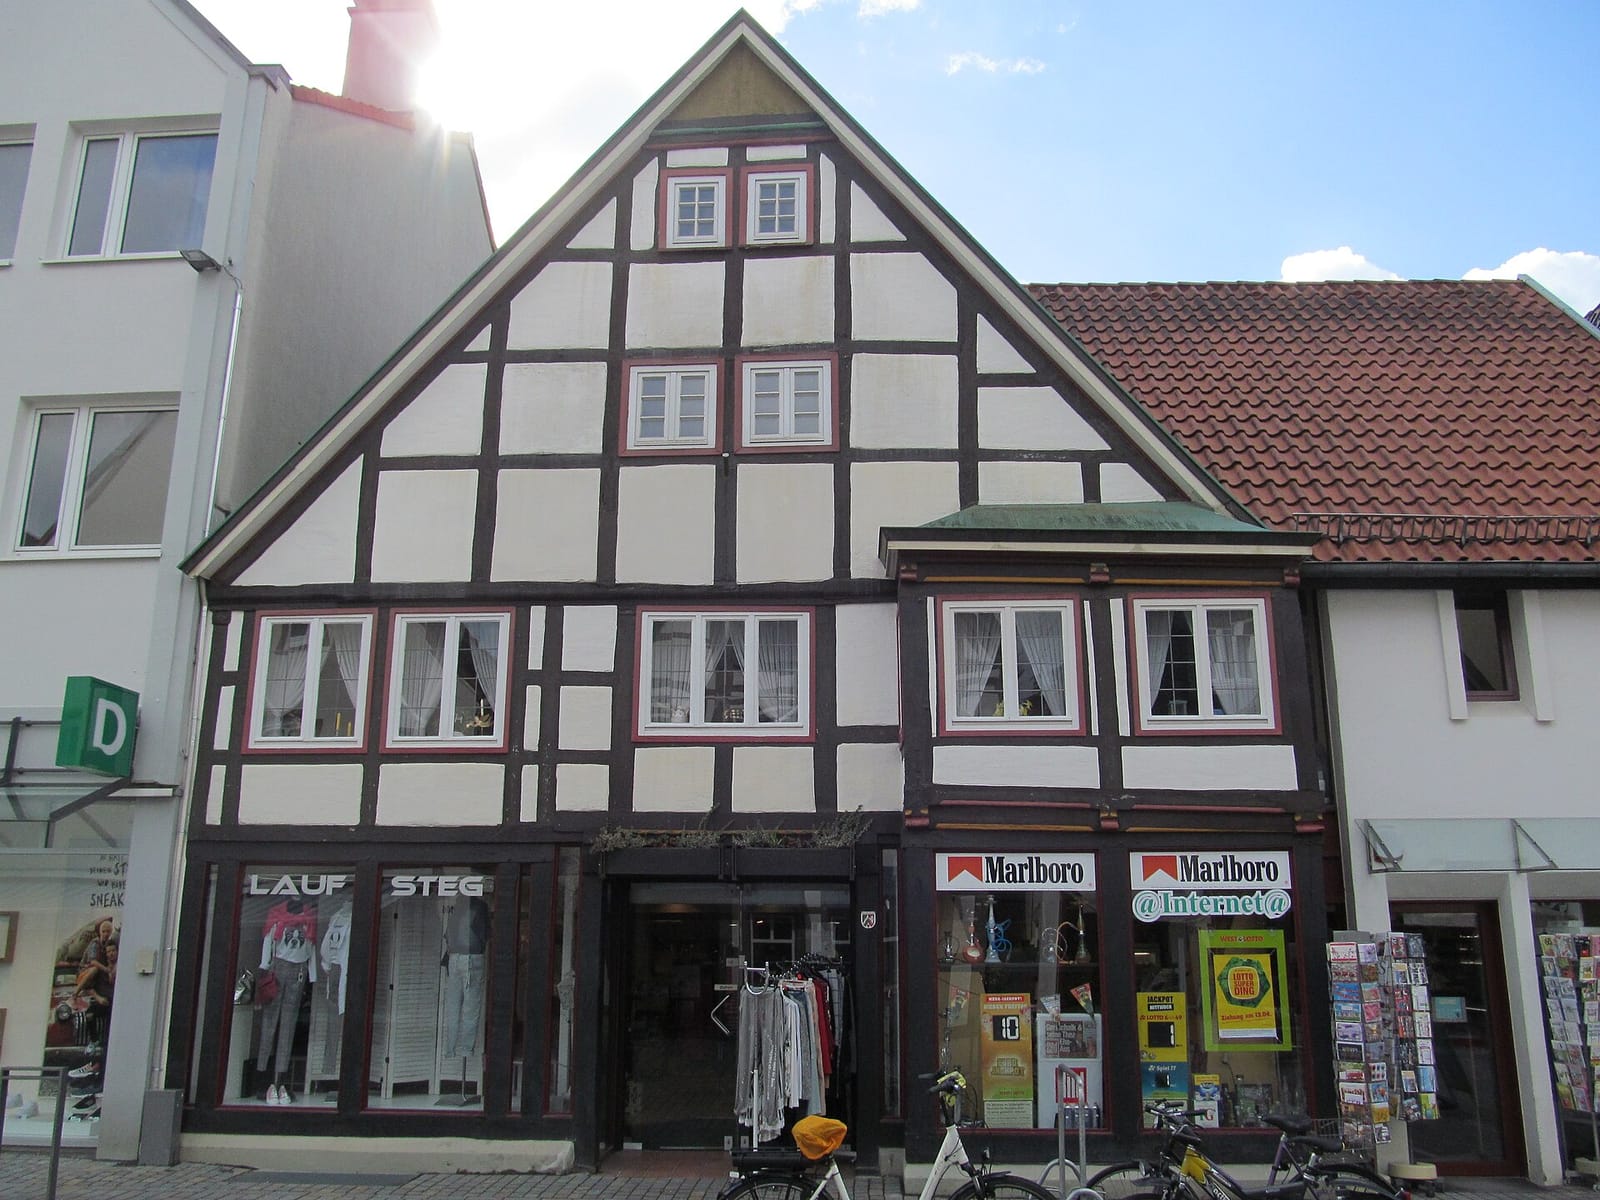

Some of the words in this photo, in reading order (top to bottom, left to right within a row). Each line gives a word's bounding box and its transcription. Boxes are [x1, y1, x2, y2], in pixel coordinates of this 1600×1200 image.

[92, 698, 126, 756] D
[985, 856, 1084, 884] Marlboro
[1179, 855, 1279, 883] Marlboro
[249, 874, 347, 896] LAUF
[391, 875, 485, 897] STEG
[1133, 889, 1291, 922] @Internet@
[1233, 972, 1254, 981] LOTTO
[1234, 980, 1254, 988] SUPER
[1147, 995, 1174, 1003] JACKPOT
[1234, 987, 1255, 996] DING
[1002, 1016, 1019, 1039] 10
[1170, 1024, 1175, 1046] 1
